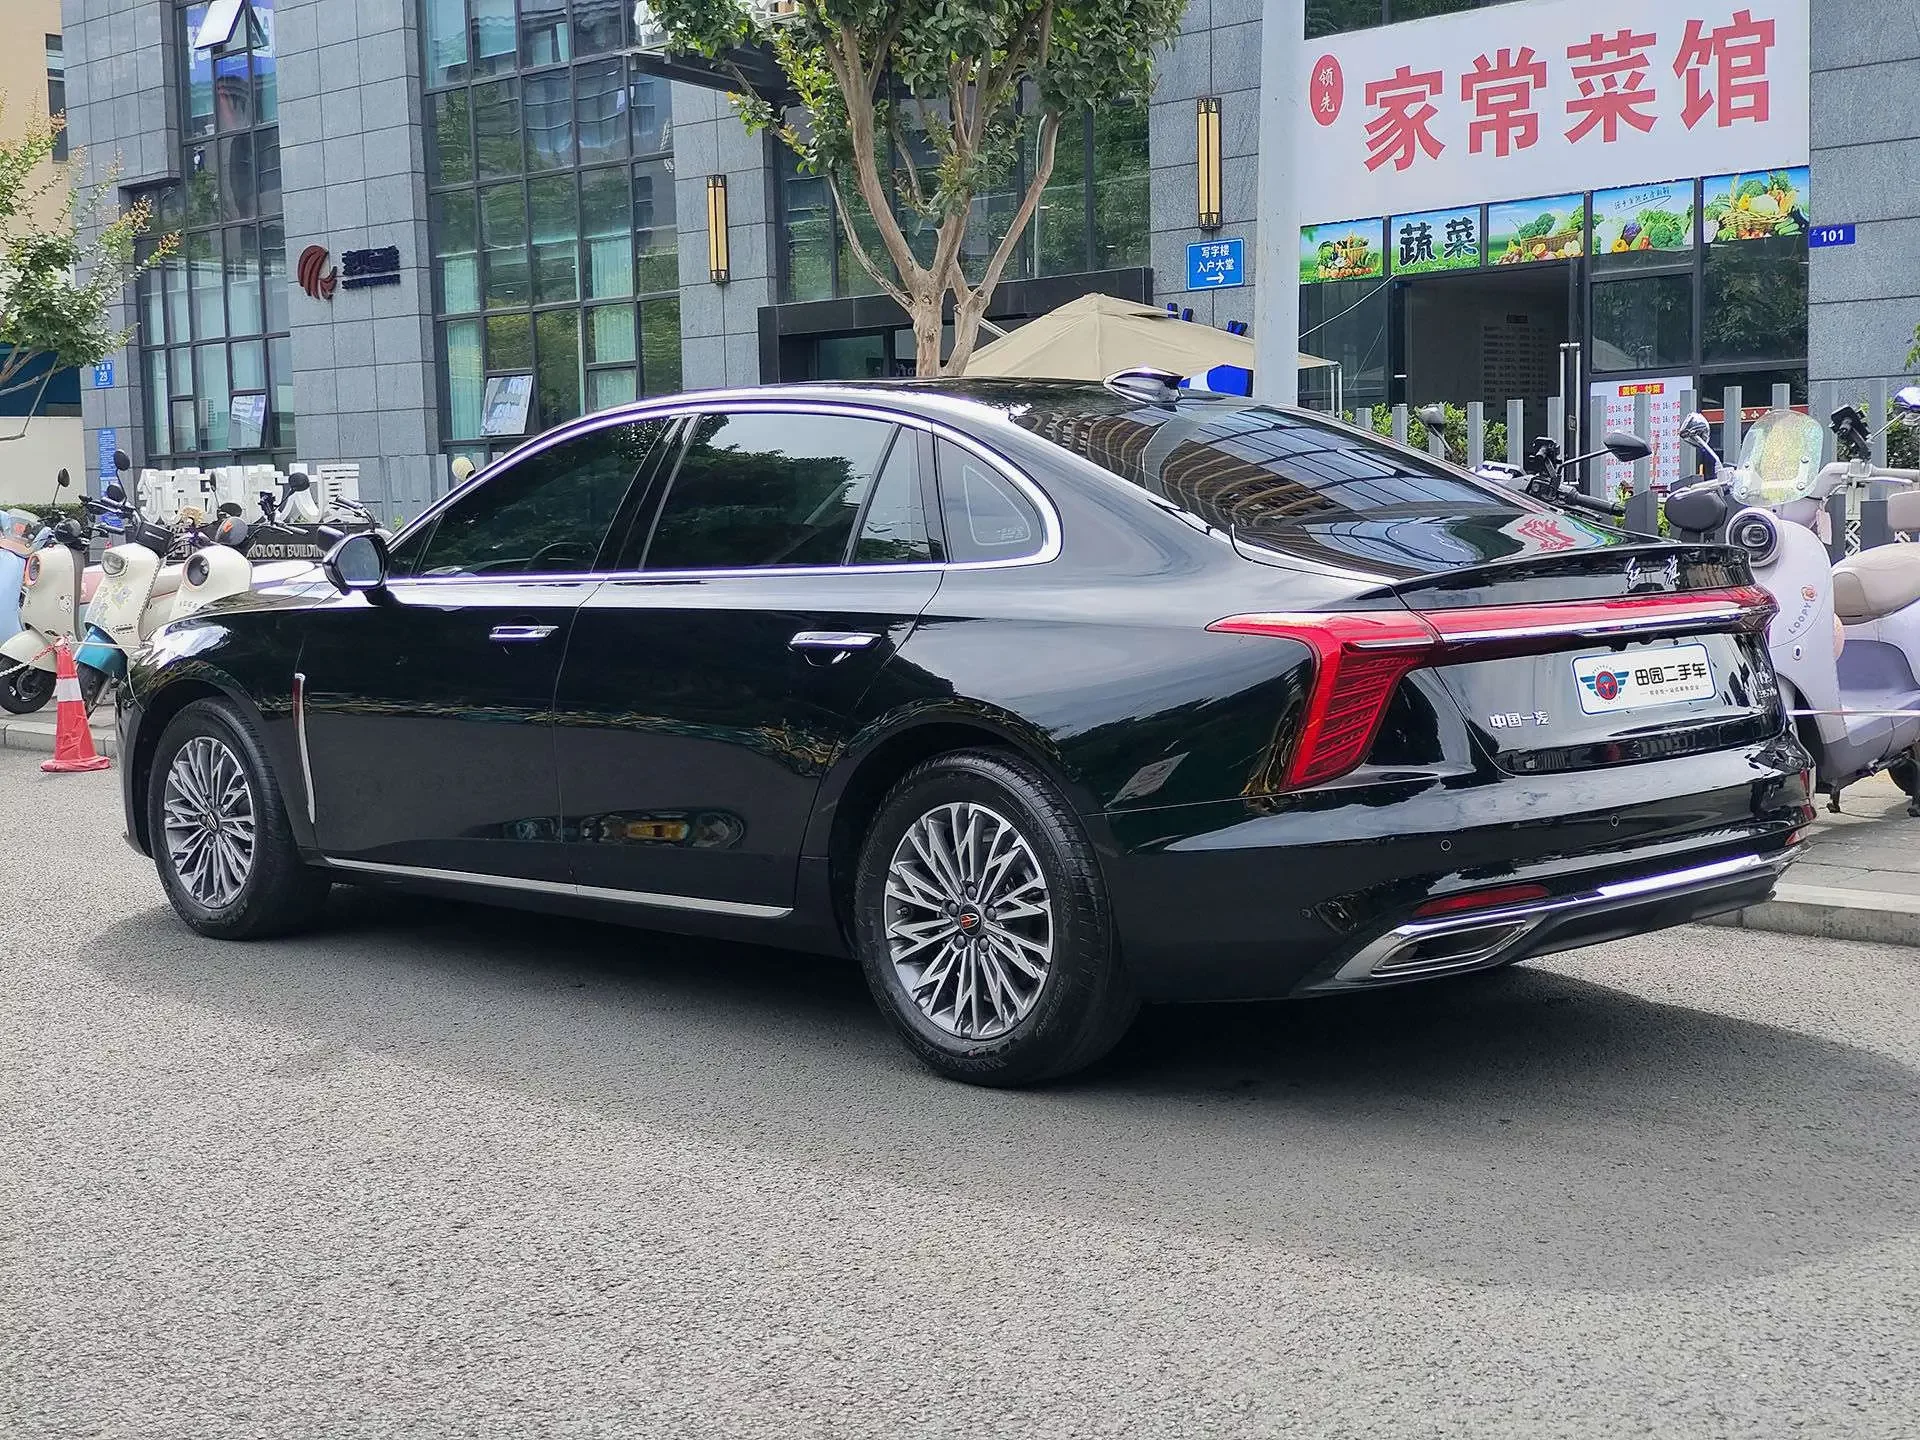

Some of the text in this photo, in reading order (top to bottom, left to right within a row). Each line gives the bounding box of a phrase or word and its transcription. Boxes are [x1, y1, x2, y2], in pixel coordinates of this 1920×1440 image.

[1319, 67, 1336, 113] 领先
[1363, 9, 1776, 172] 家常菜馆
[1399, 217, 1477, 266] 蔬菜
[1821, 229, 1844, 243] 101
[1197, 257, 1234, 272] 入户大堂
[1202, 244, 1229, 258] 写字楼
[1624, 554, 1681, 589] 红旗
[1788, 602, 1811, 634] LOOPY
[1635, 662, 1707, 686] 田园二手车
[1489, 710, 1550, 729] 中国一汽
